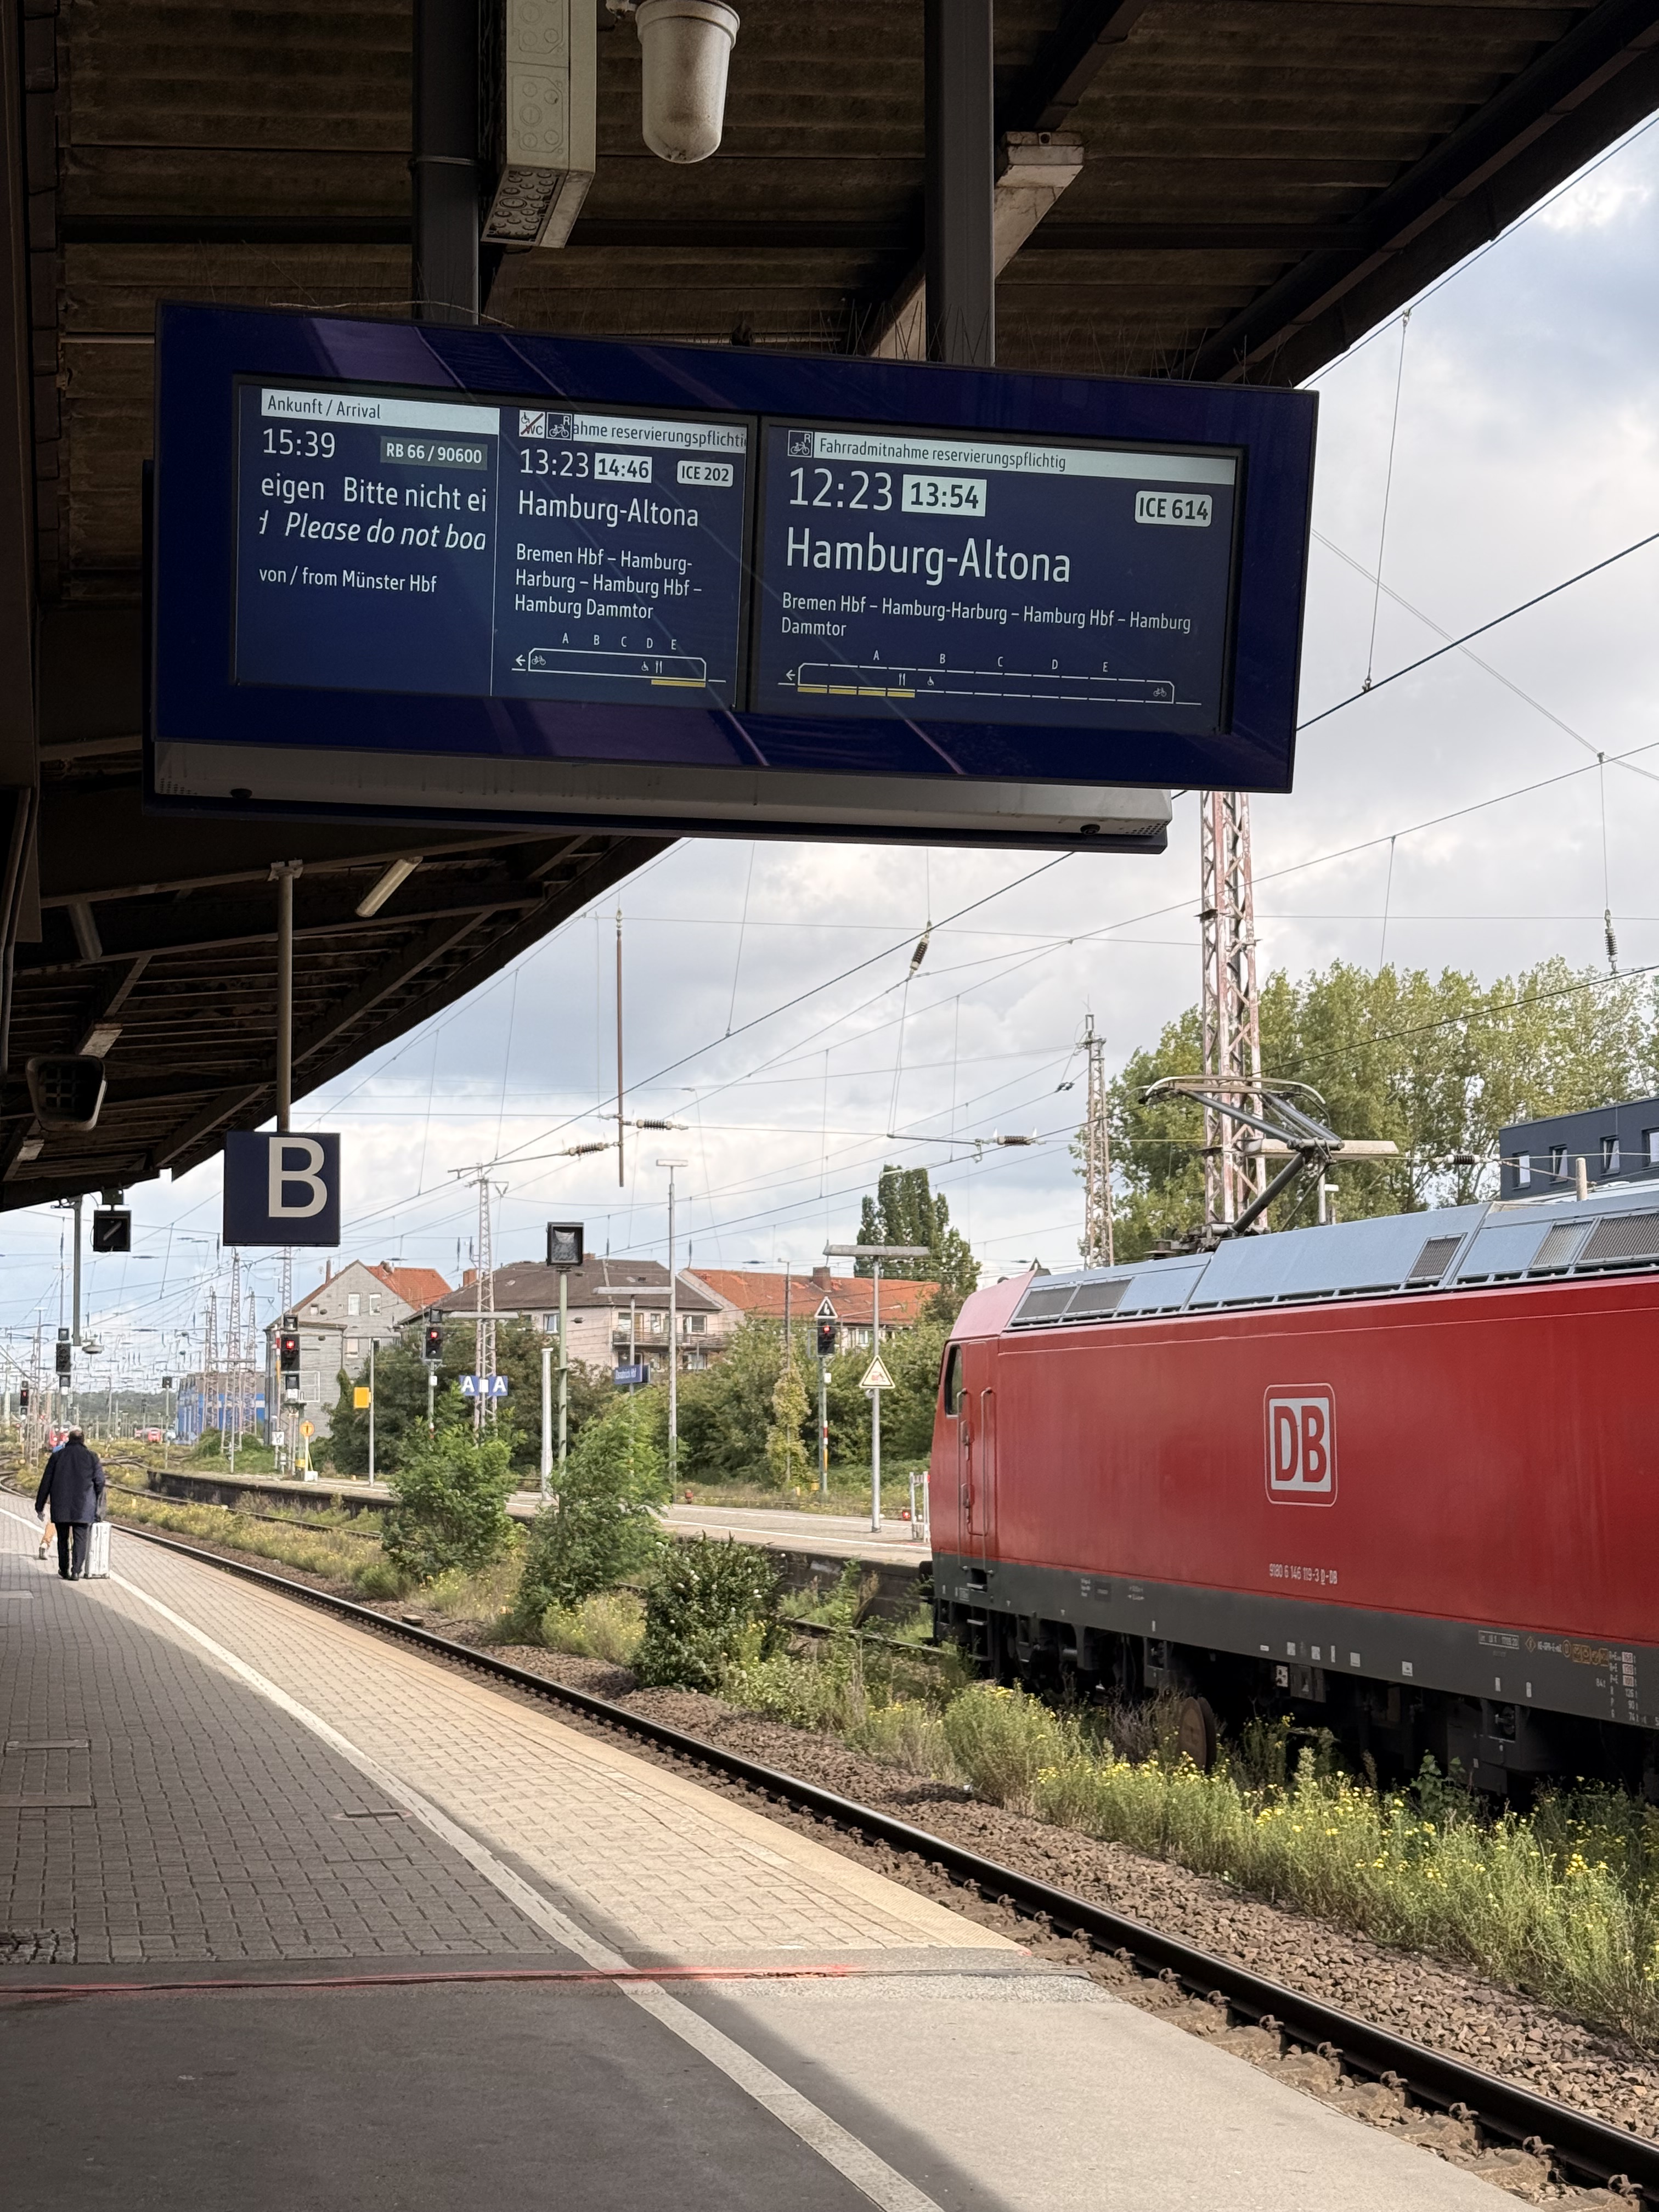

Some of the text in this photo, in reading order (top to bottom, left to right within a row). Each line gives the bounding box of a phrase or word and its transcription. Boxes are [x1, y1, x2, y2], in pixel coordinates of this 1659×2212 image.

[267, 394, 381, 419] Ankunft / Arrival
[526, 425, 543, 435] WC
[563, 416, 570, 426] R
[573, 421, 607, 437] ahme
[263, 428, 335, 458] 15:39
[804, 433, 811, 443] R
[386, 442, 482, 464] RB 66 / 90600
[820, 438, 1066, 471] Fahrradmitnahme reservierungspflichtig
[521, 448, 649, 478] 13:23 14:46
[682, 465, 729, 482] ICE 202
[261, 472, 486, 512] eigen Bitte nicht ei
[789, 467, 979, 511] 12:23 13:54
[519, 489, 698, 527] Hamburg-Altona
[1139, 497, 1209, 521] ICE 614
[285, 511, 361, 541] Please
[366, 518, 394, 544] do
[400, 525, 440, 548] not
[445, 523, 486, 550] boa
[517, 543, 572, 563] Bremen
[578, 547, 604, 565] Hbf
[621, 550, 692, 575] Hamburg-
[787, 527, 1070, 586] Hamburg-Altona
[259, 566, 437, 592] von / from Münster Hbf
[516, 568, 575, 593] Harburg
[593, 573, 659, 599] Hamburg
[664, 578, 690, 596] Hbf
[515, 594, 654, 619] Hamburg Dammtor
[783, 592, 836, 611] Bremen
[840, 595, 866, 613] Hbf
[882, 597, 1007, 625] Hamburg-Harburg
[1024, 605, 1085, 629] Hamburg
[1090, 609, 1115, 627] Hbf
[1130, 611, 1190, 634] Hamburg
[782, 617, 847, 636] Dammtor
[562, 633, 569, 644] A
[594, 634, 600, 645] B
[621, 636, 627, 647] C
[646, 637, 653, 648] D
[671, 639, 677, 650] E
[873, 650, 879, 661] A
[940, 653, 946, 664] B
[997, 656, 1003, 667] C
[1052, 659, 1058, 670] D
[1103, 662, 1108, 672] E
[268, 1137, 328, 1218] B
[461, 1376, 475, 1392] A
[493, 1376, 506, 1392] A
[1274, 1406, 1327, 1482] DB
[1284, 1565, 1289, 1578] 6
[1290, 1565, 1301, 1580] 146
